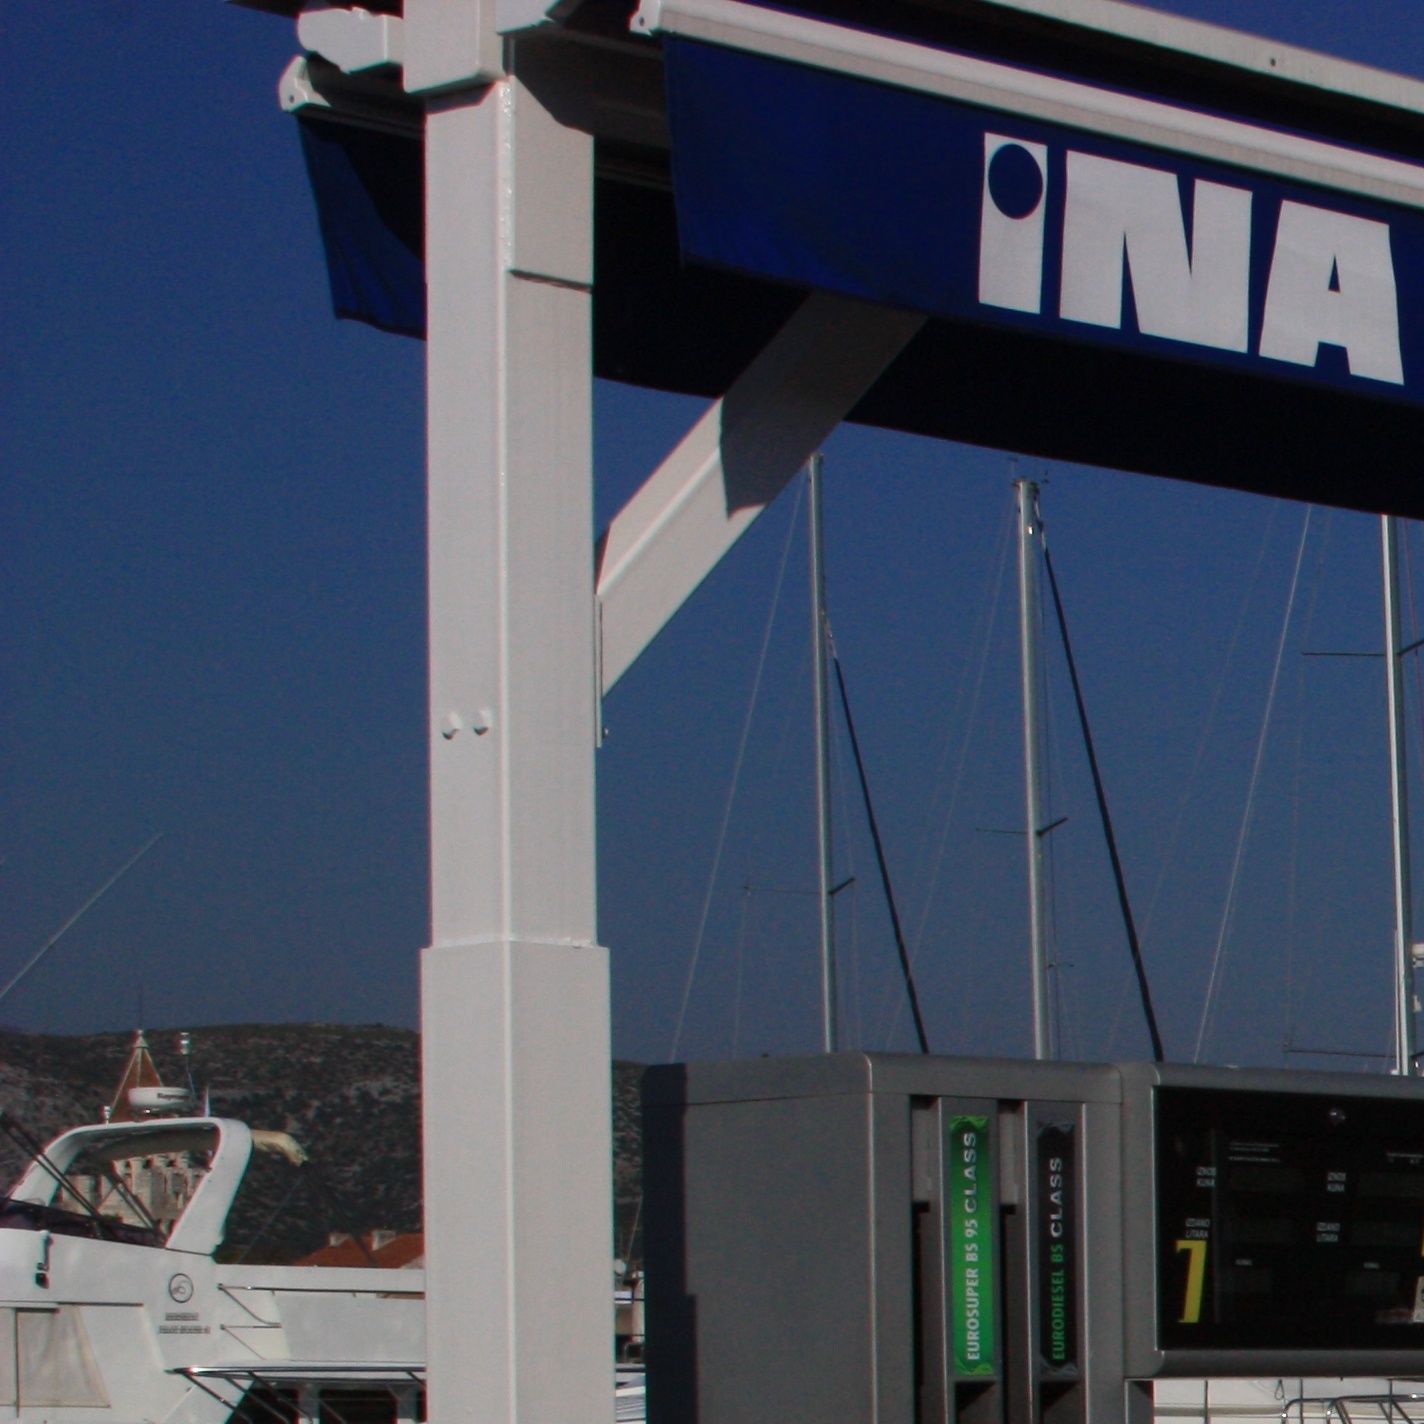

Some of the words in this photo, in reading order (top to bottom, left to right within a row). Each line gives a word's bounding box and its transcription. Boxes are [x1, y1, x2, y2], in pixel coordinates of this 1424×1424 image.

[962, 1132, 977, 1214] CLASS
[1049, 1157, 1063, 1239] CLASS
[964, 1218, 979, 1239] 95
[964, 1267, 981, 1361] EUROSUPER
[1051, 1269, 1066, 1361] EURODIESEL
